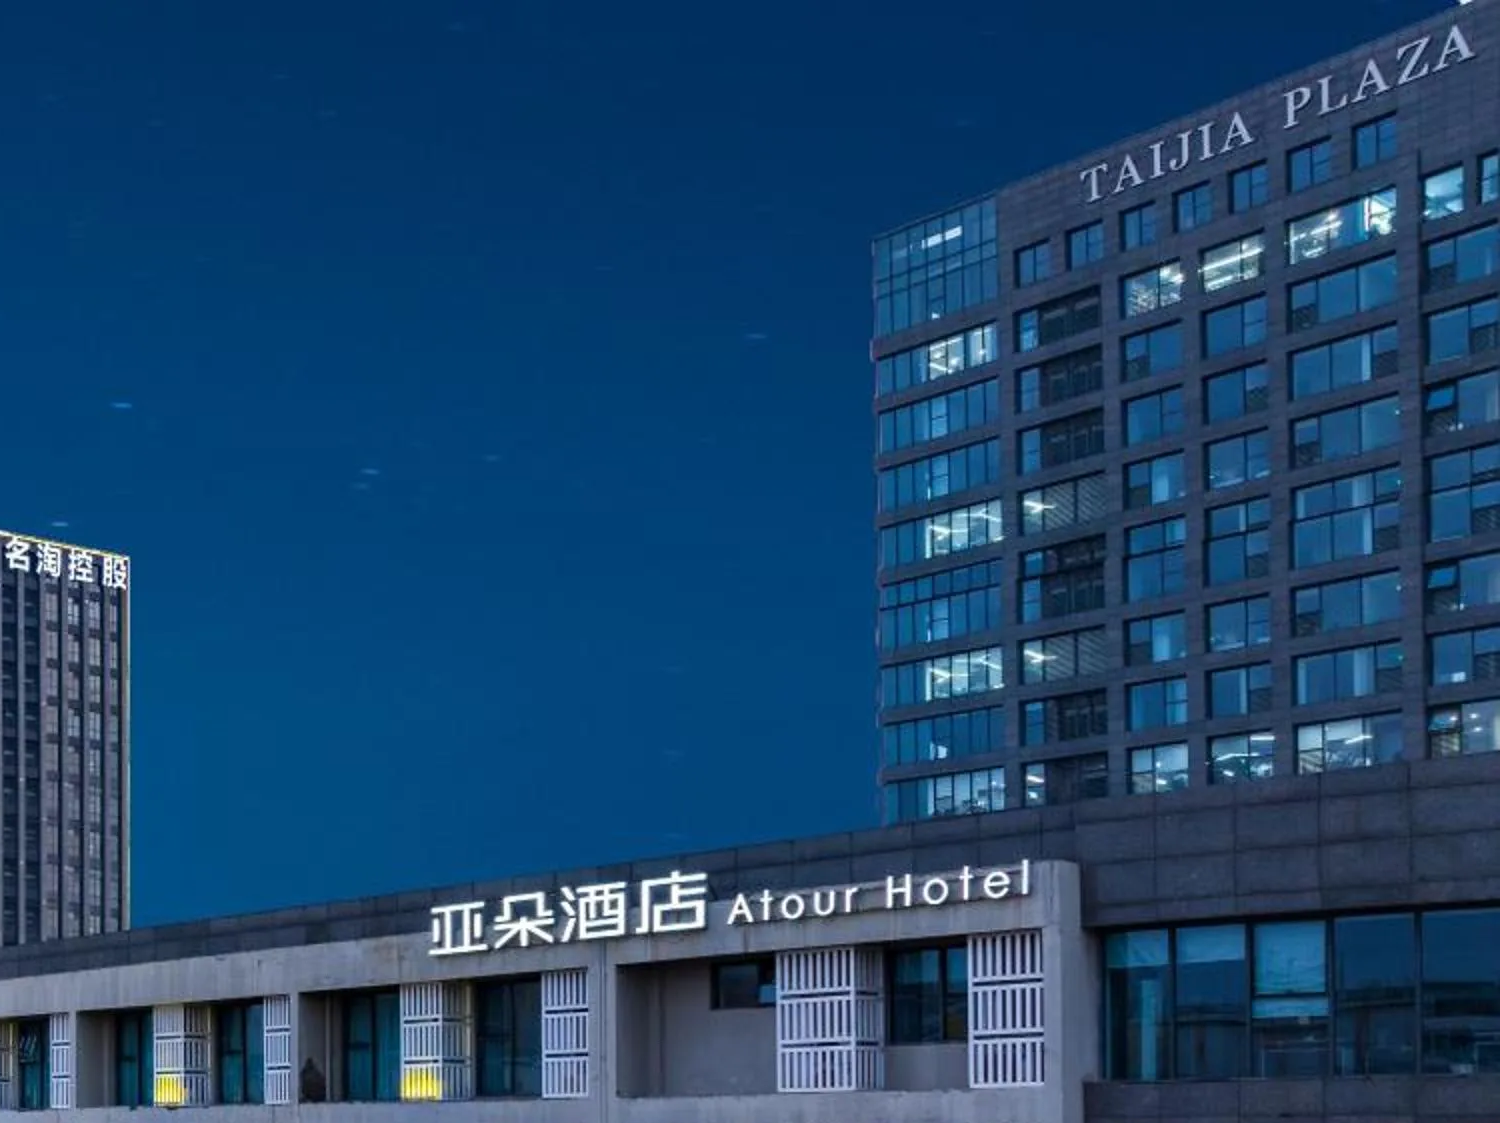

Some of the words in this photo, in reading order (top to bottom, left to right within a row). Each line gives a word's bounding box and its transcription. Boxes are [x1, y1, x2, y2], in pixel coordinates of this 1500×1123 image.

[1080, 111, 1255, 203] TAIJIA
[1282, 24, 1476, 130] PLAZA
[4, 536, 128, 590] 名淘控股
[427, 870, 709, 957] 亚朵酒店
[726, 884, 860, 926] Atour
[885, 859, 1032, 909] Hotel
